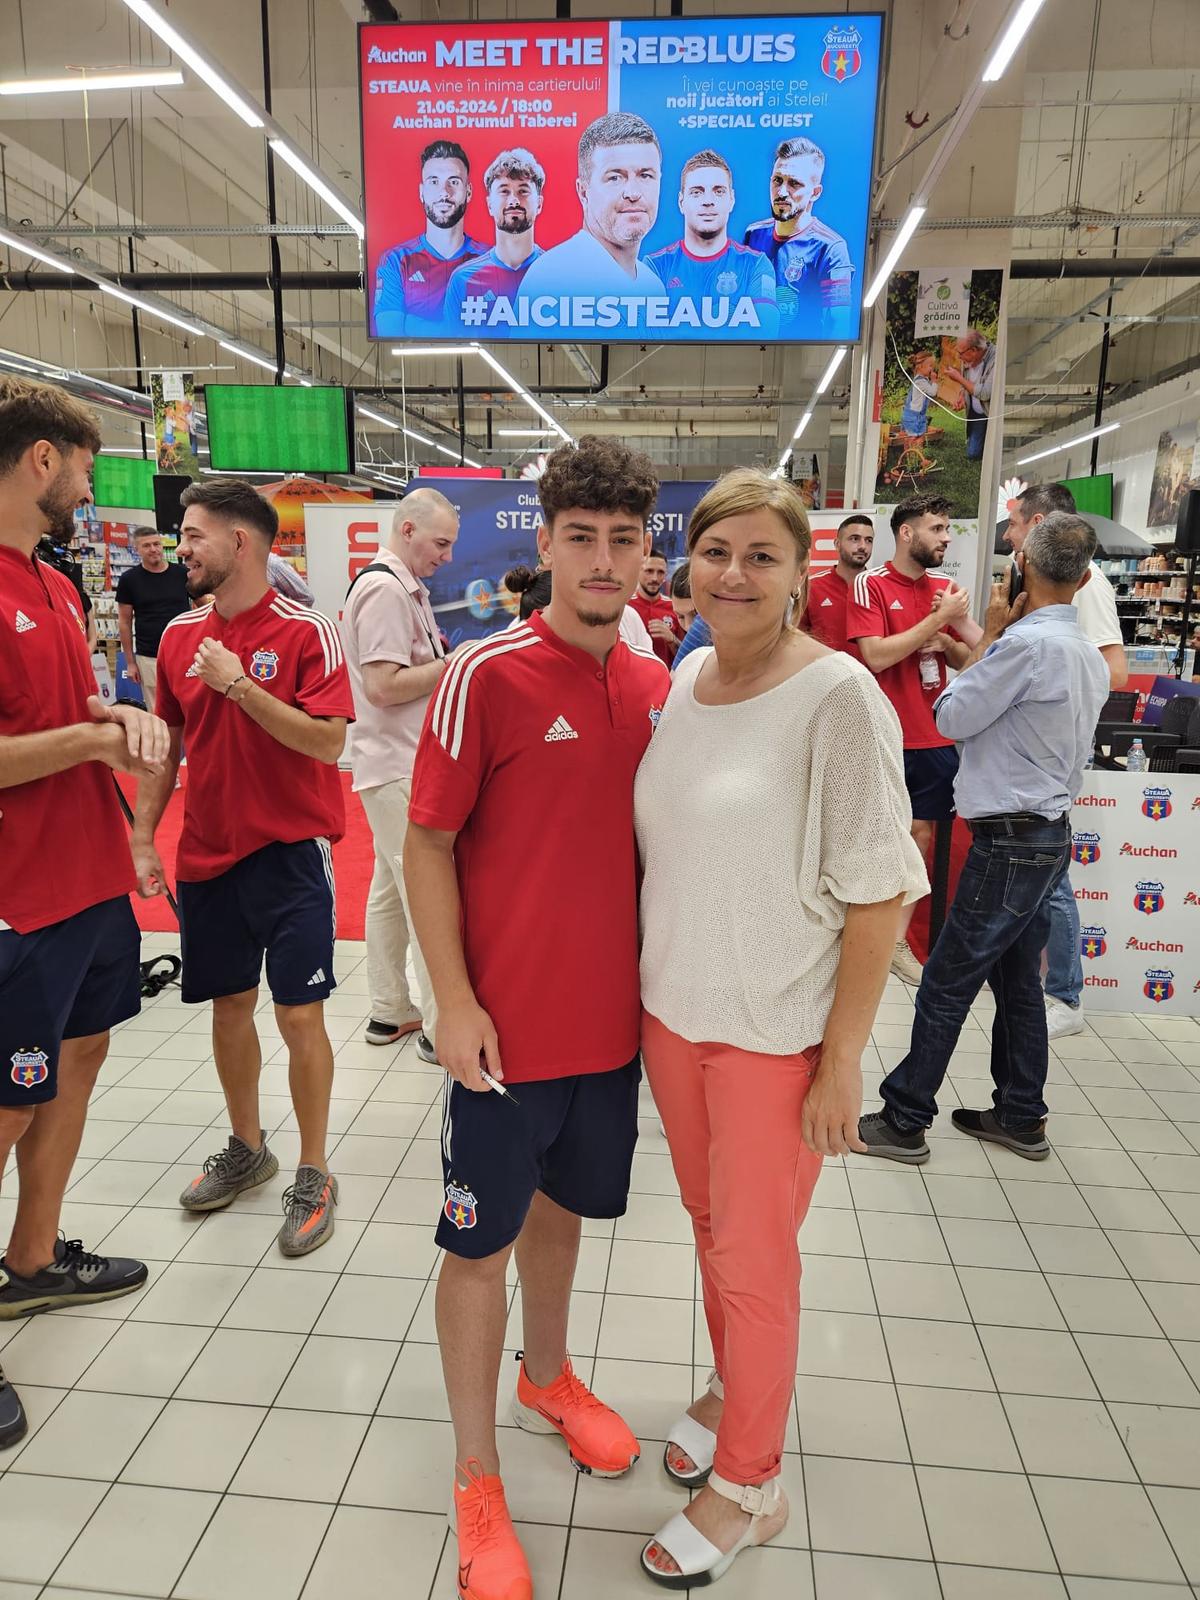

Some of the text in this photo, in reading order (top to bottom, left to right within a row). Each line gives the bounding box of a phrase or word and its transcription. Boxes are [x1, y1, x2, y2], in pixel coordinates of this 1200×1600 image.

[827, 33, 858, 43] STEAUA
[368, 44, 427, 64] Auchan
[435, 39, 527, 67] MEET
[536, 37, 603, 66] THE
[369, 76, 601, 94] STEAUA vine în inima cartierului!
[695, 77, 714, 92] vei
[789, 79, 809, 93] pe
[416, 98, 553, 114] 21.06.2024 / 18:00
[666, 92, 828, 110] noii jucători ai Stelei!
[392, 112, 577, 129] Auchan Drumul Taberei
[678, 113, 813, 129] +SPECIAL GUEST
[460, 294, 762, 329] #AICIESTEAUA
[923, 311, 961, 323] grădina
[495, 511, 545, 529] STEA
[544, 731, 579, 742] adidas
[1073, 795, 1117, 807] uchan
[1119, 842, 1178, 858] Auchan
[1074, 888, 1109, 901] chan
[1125, 937, 1184, 953] Auchan
[1084, 975, 1119, 988] chan
